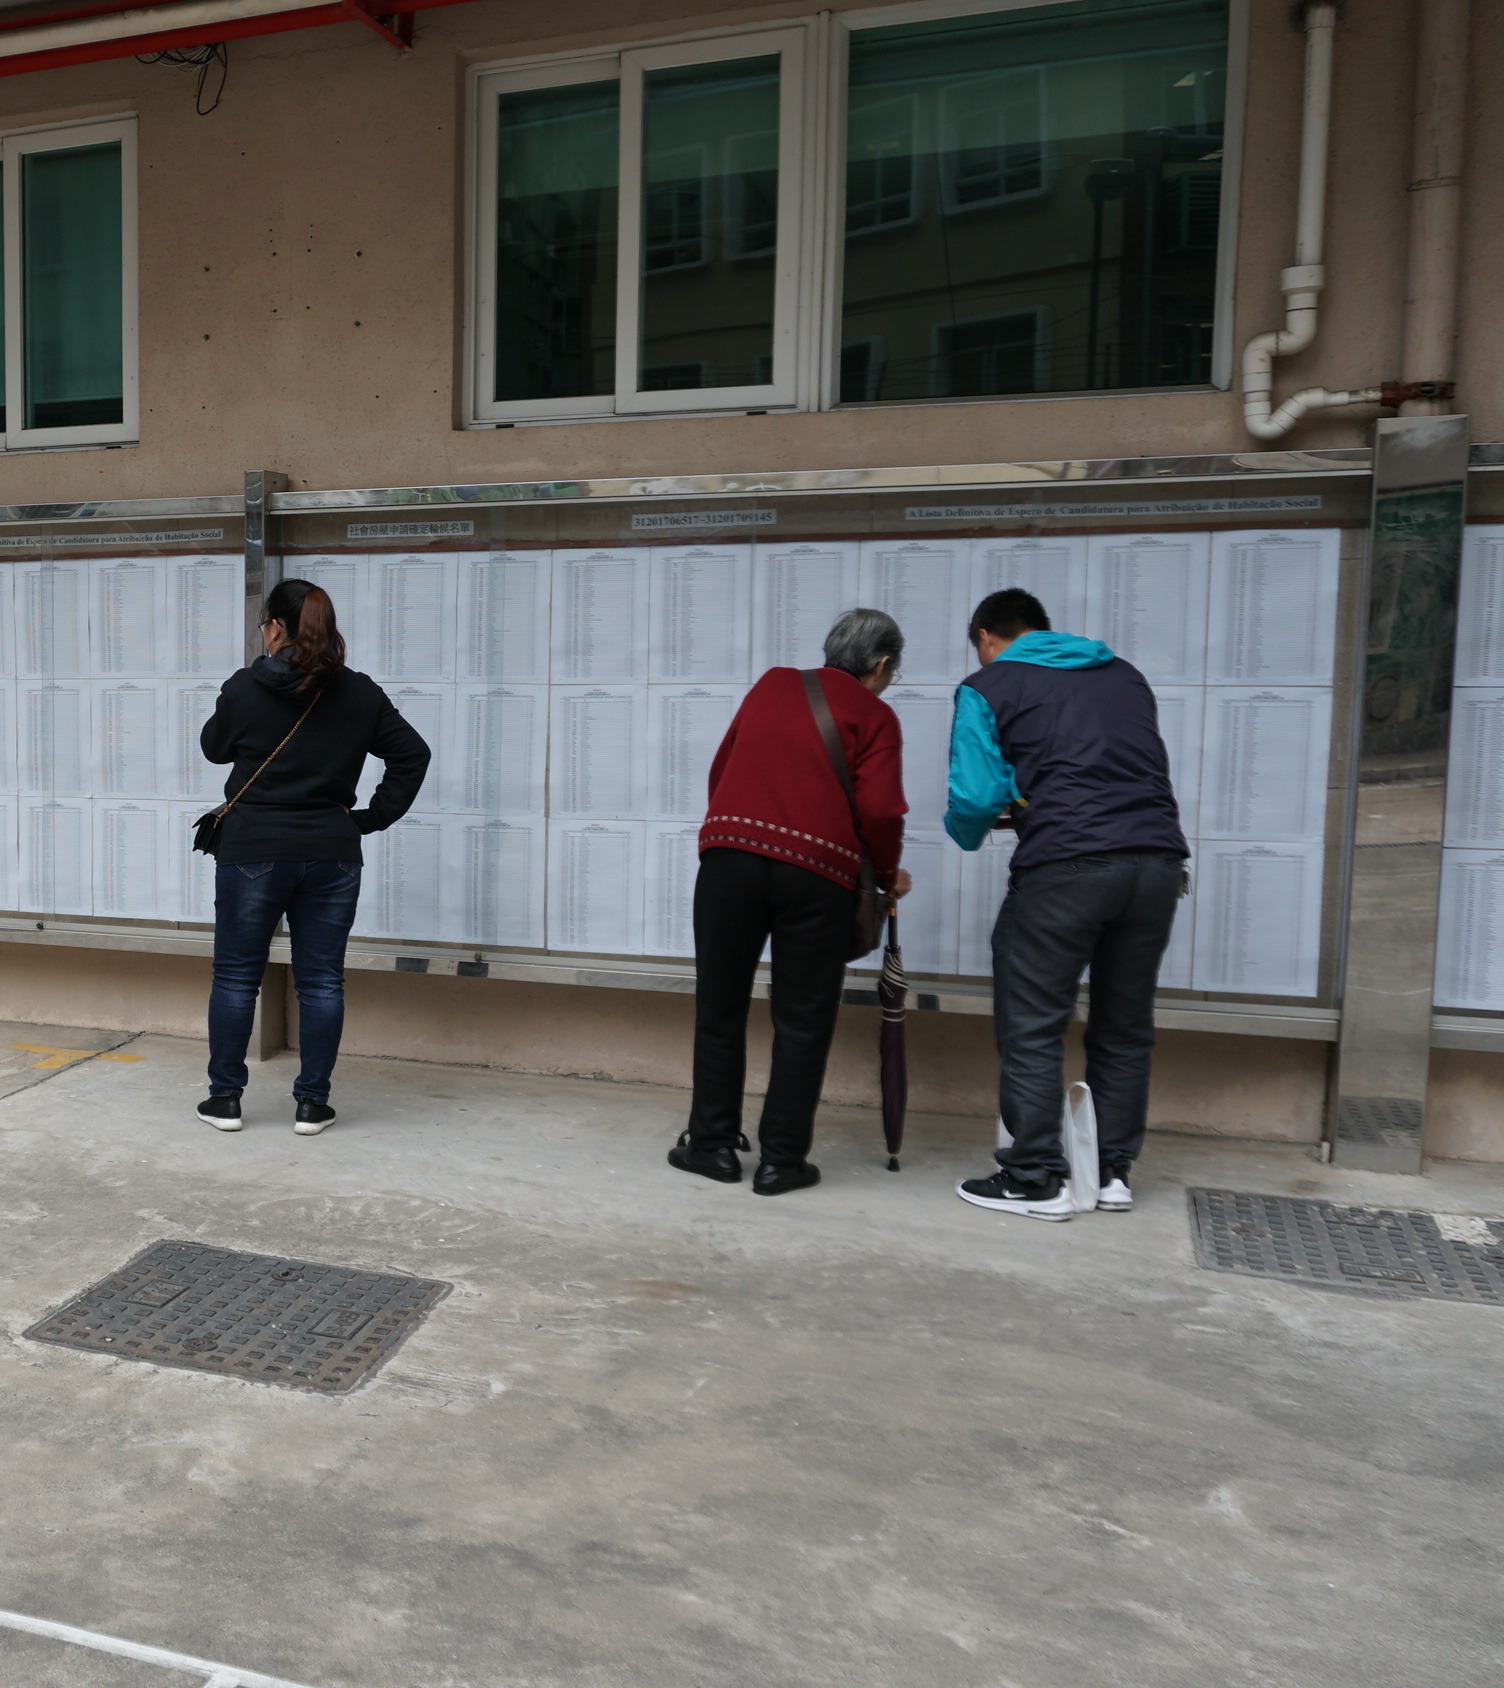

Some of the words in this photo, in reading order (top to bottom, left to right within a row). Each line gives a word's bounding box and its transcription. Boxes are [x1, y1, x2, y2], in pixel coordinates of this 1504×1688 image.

[920, 510, 942, 518] Lista
[946, 508, 991, 517] Definitiva
[994, 508, 1006, 516] de
[1008, 507, 1042, 518] Espera
[1045, 506, 1056, 515] de
[1060, 504, 1124, 514] Candidatura
[1127, 504, 1150, 515] para
[1154, 502, 1209, 514] Atribuição
[1212, 502, 1225, 510] de
[1228, 500, 1282, 511] Habitação
[1284, 498, 1318, 508] Social
[634, 512, 772, 527] 31201706517~31201709145
[349, 522, 470, 536] 社會房屋申請確定輪候名單
[58, 536, 100, 544] Candidatura
[101, 537, 116, 545] para
[118, 535, 152, 544] Atribuição
[165, 533, 198, 542] Habitação
